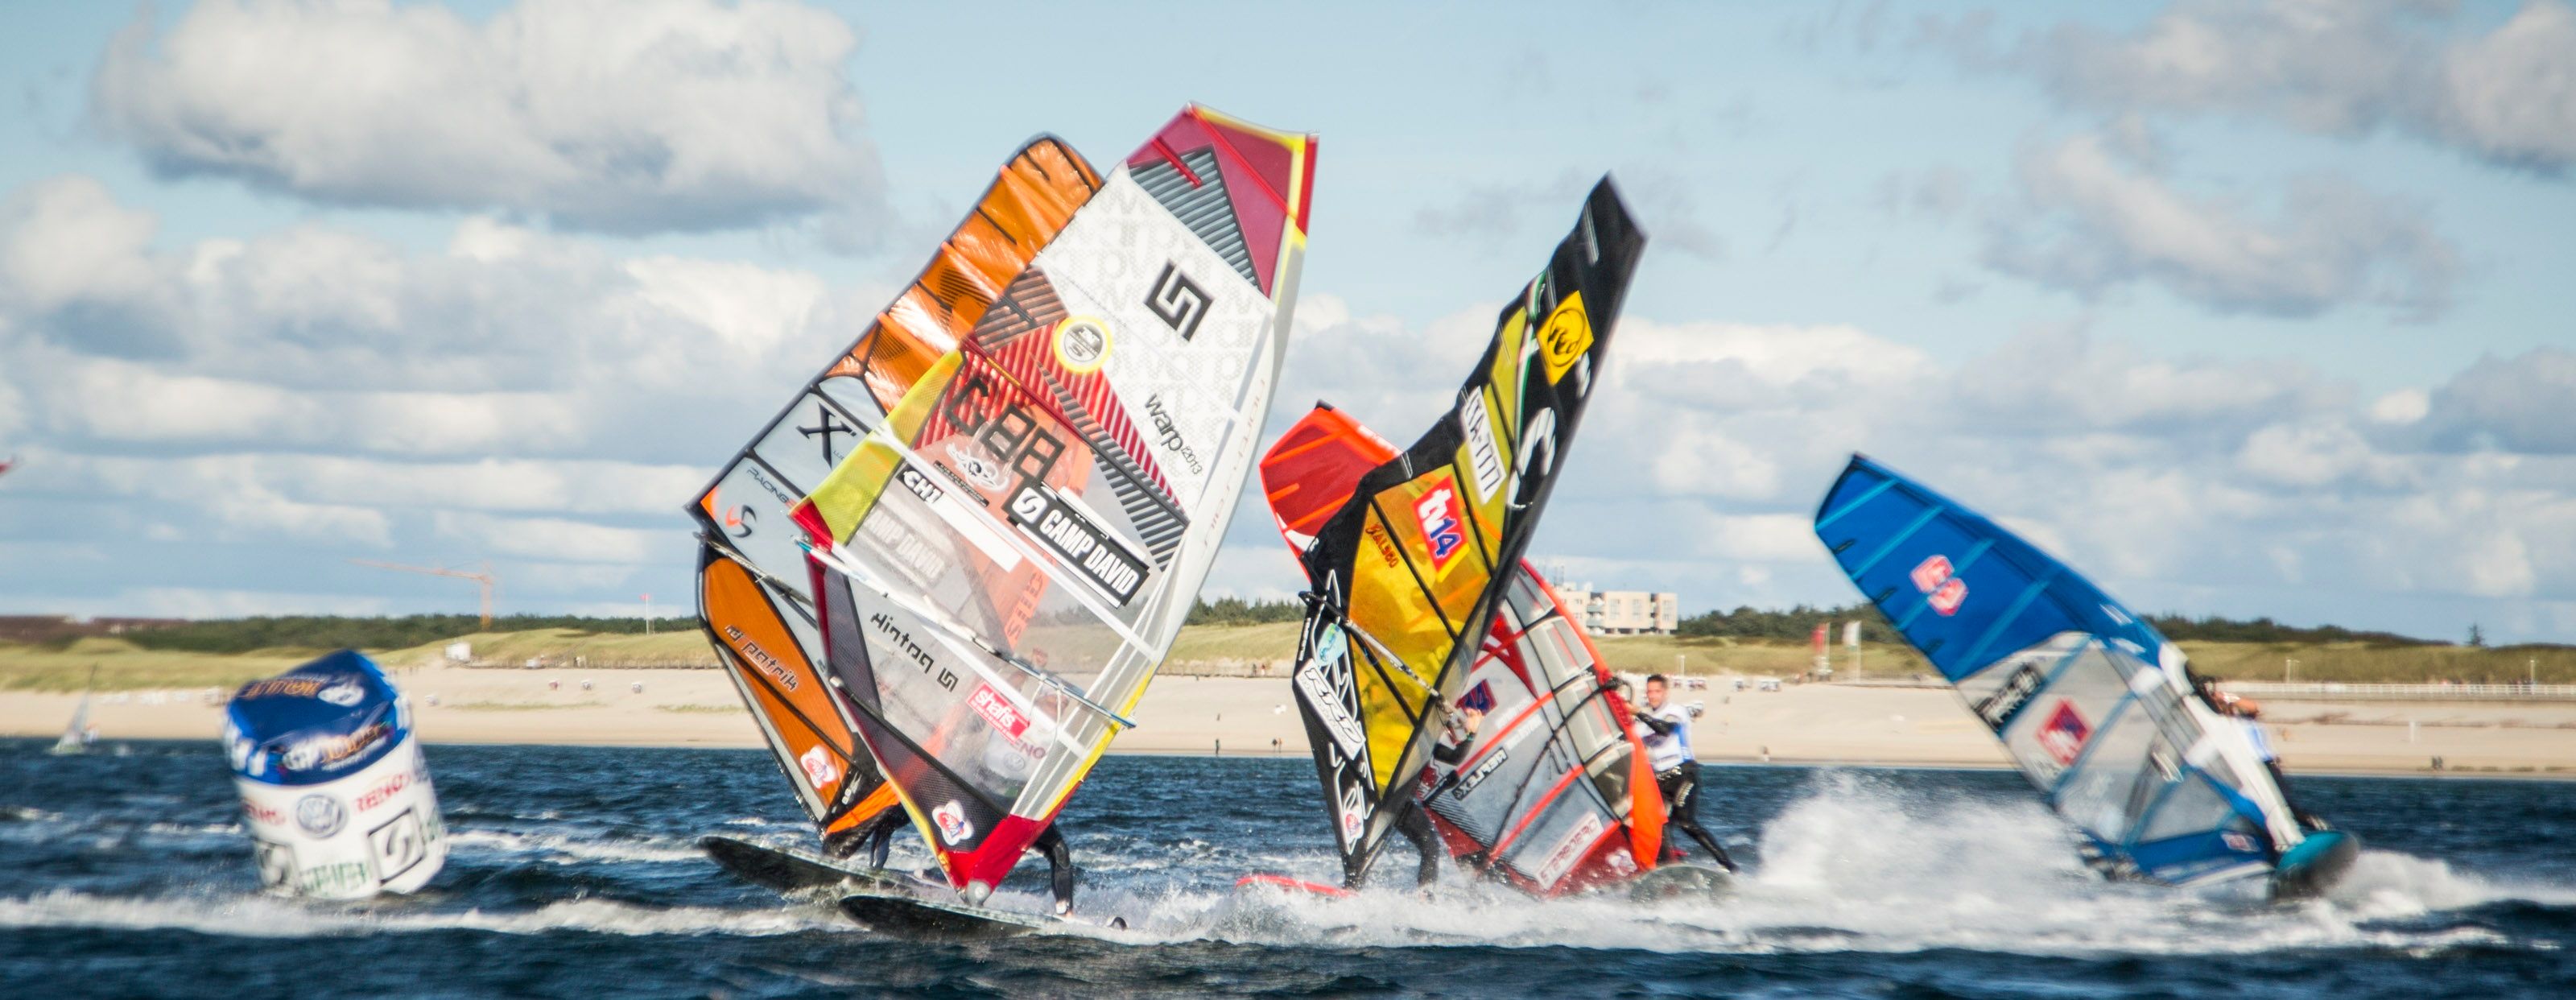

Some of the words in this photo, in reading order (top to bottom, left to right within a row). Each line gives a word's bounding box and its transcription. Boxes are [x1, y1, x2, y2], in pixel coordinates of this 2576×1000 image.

[1144, 392, 1184, 452] warp
[746, 467, 788, 504] RACING
[1039, 509, 1095, 559] CAMP
[1084, 543, 1141, 596] DAVID
[1418, 487, 1463, 560] tv14
[740, 641, 799, 692] patrik
[973, 687, 1017, 731] shafis
[1304, 667, 1363, 743] RRD
